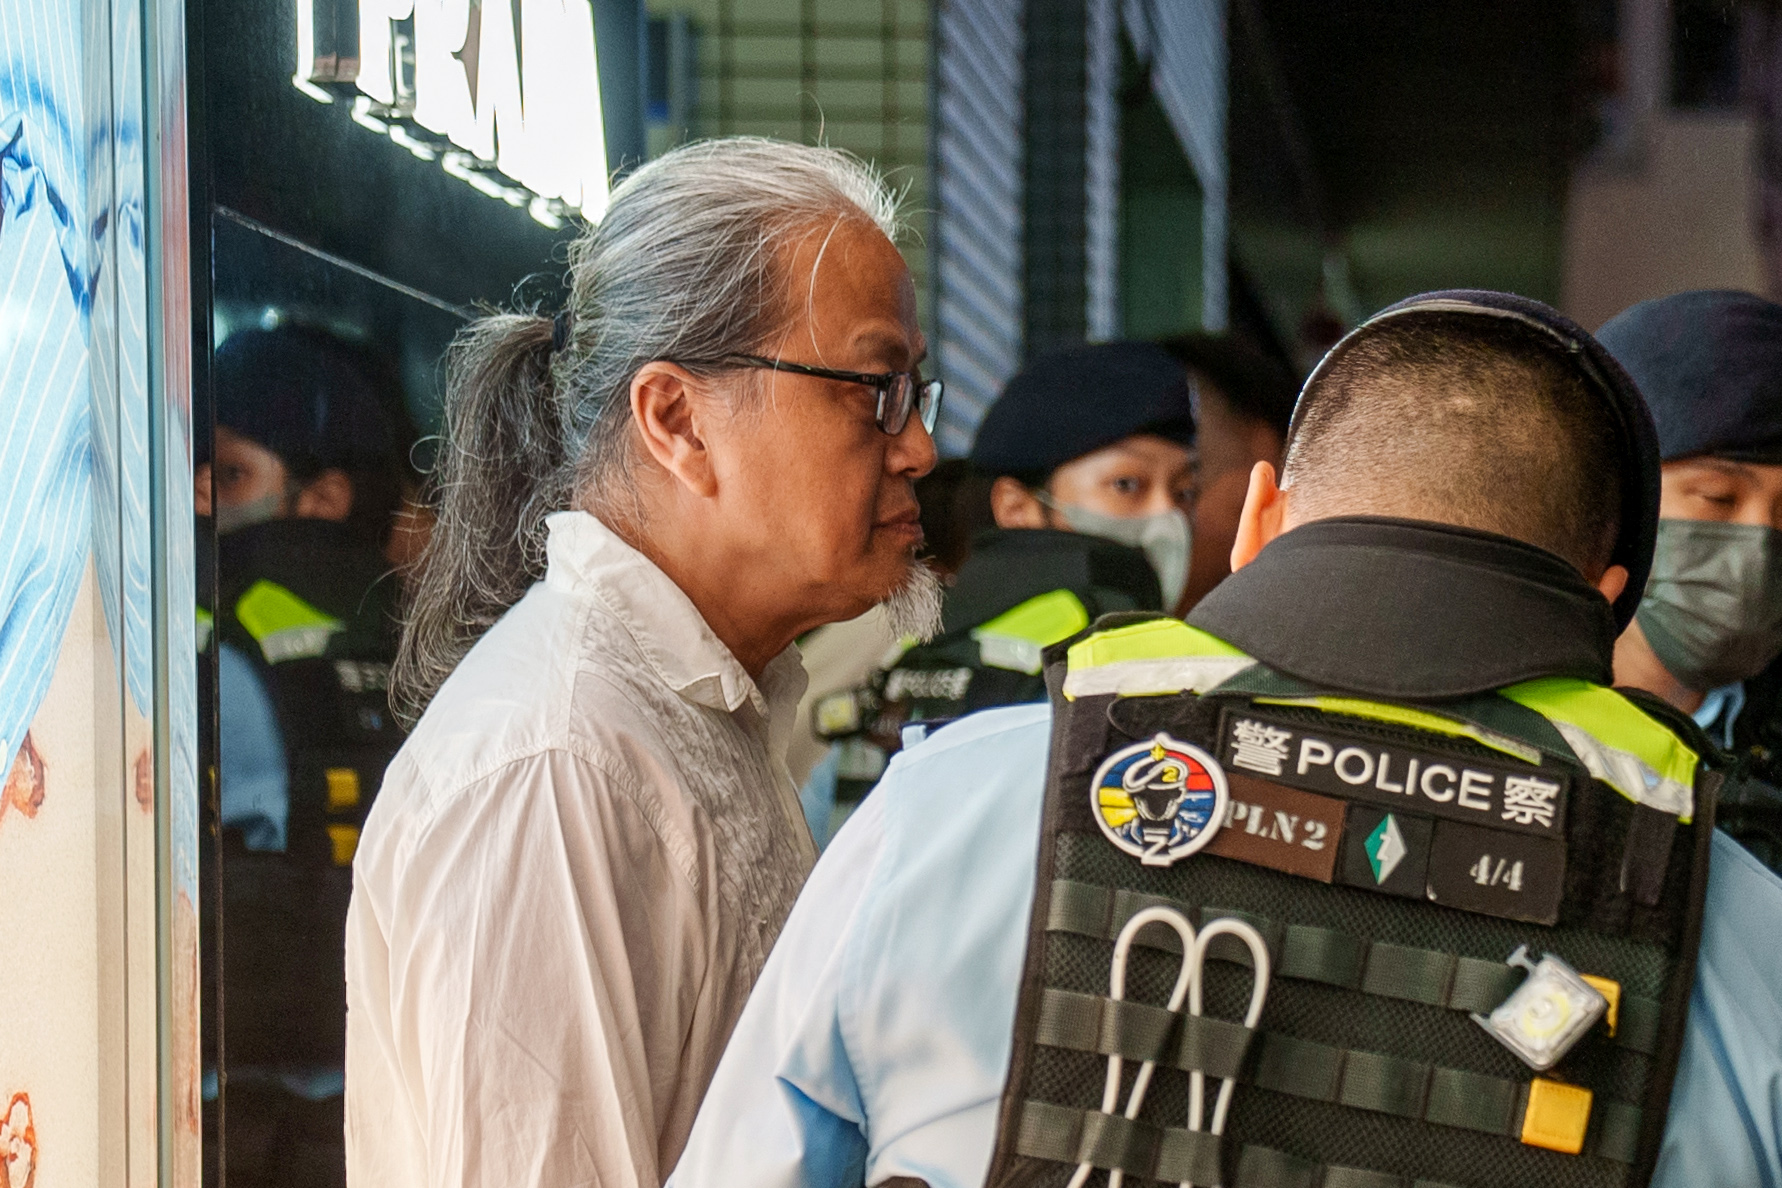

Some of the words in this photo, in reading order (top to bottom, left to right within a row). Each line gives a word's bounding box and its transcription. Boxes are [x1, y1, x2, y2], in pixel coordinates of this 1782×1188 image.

[1161, 766, 1179, 783] 2
[1230, 719, 1293, 777] 警
[1297, 738, 1494, 811] POLICE
[1501, 776, 1560, 828] 察
[1222, 799, 1300, 845] PLN
[1301, 820, 1328, 851] 2
[1469, 854, 1525, 892] 4/4
